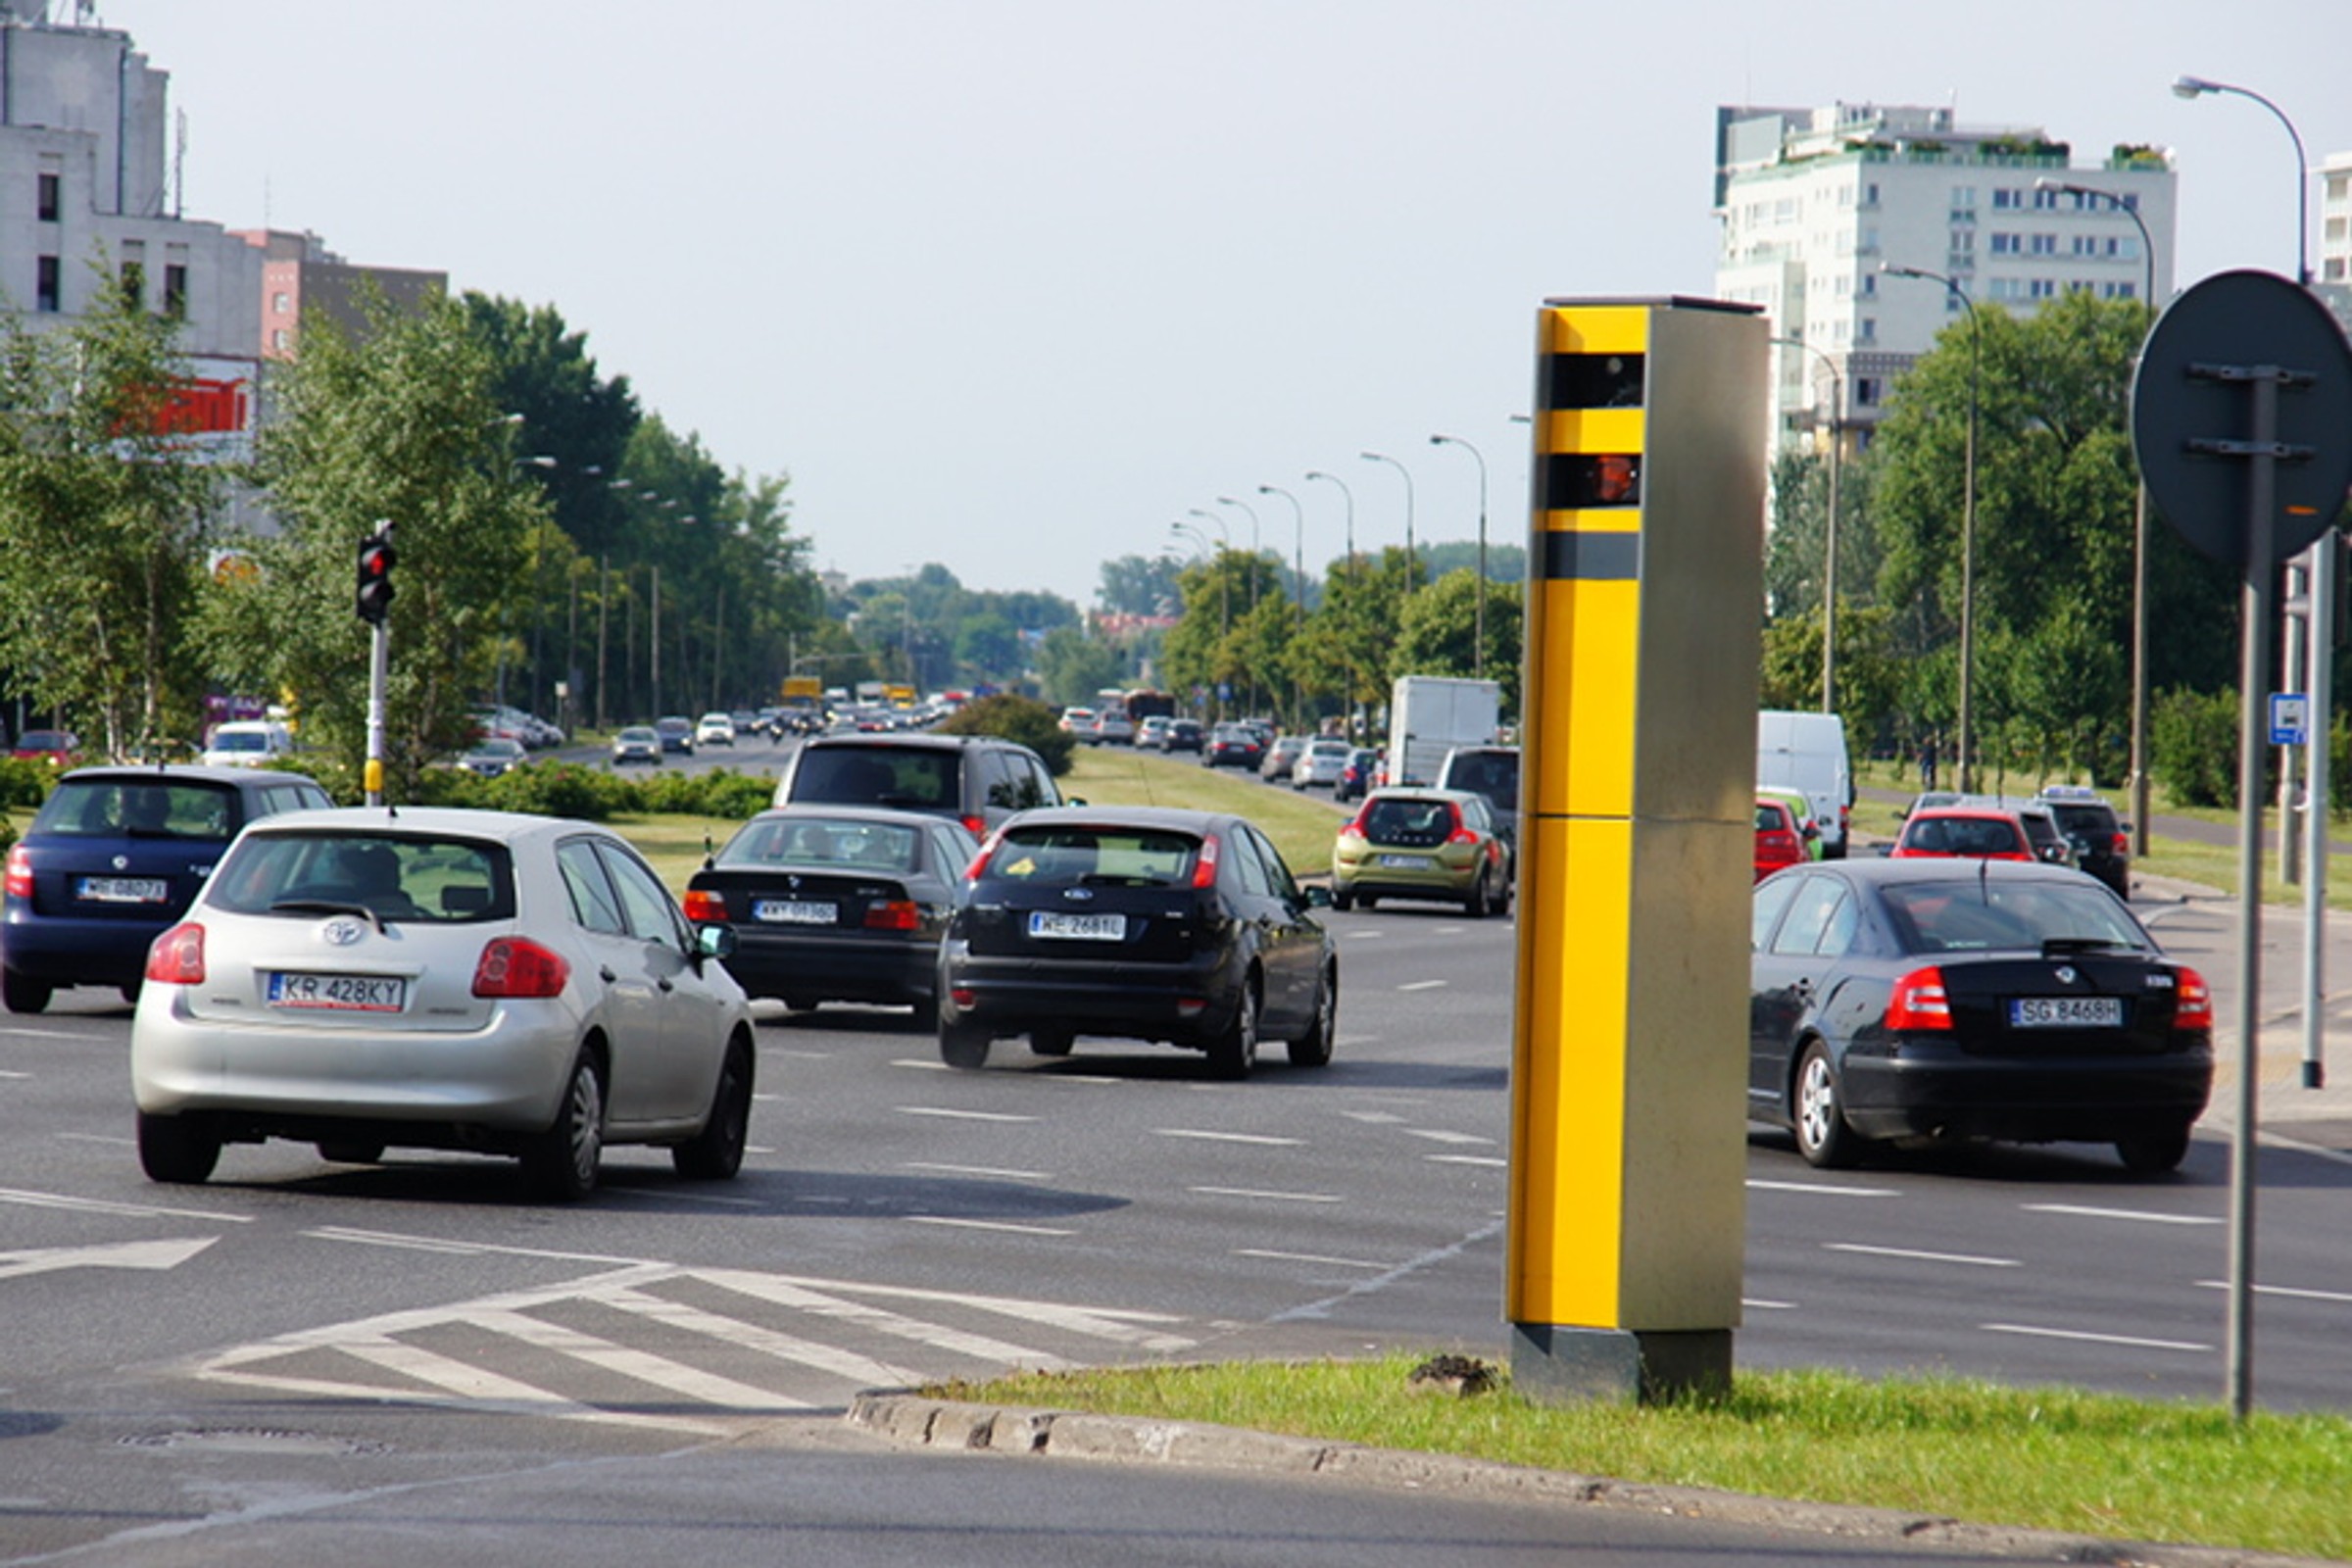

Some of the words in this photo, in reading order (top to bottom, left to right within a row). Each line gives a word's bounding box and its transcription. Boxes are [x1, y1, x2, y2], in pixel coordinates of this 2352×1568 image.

[285, 976, 319, 1001] KR
[325, 978, 399, 1004] 428KY
[2022, 999, 2053, 1021] SG
[2058, 999, 2118, 1021] 8468H
